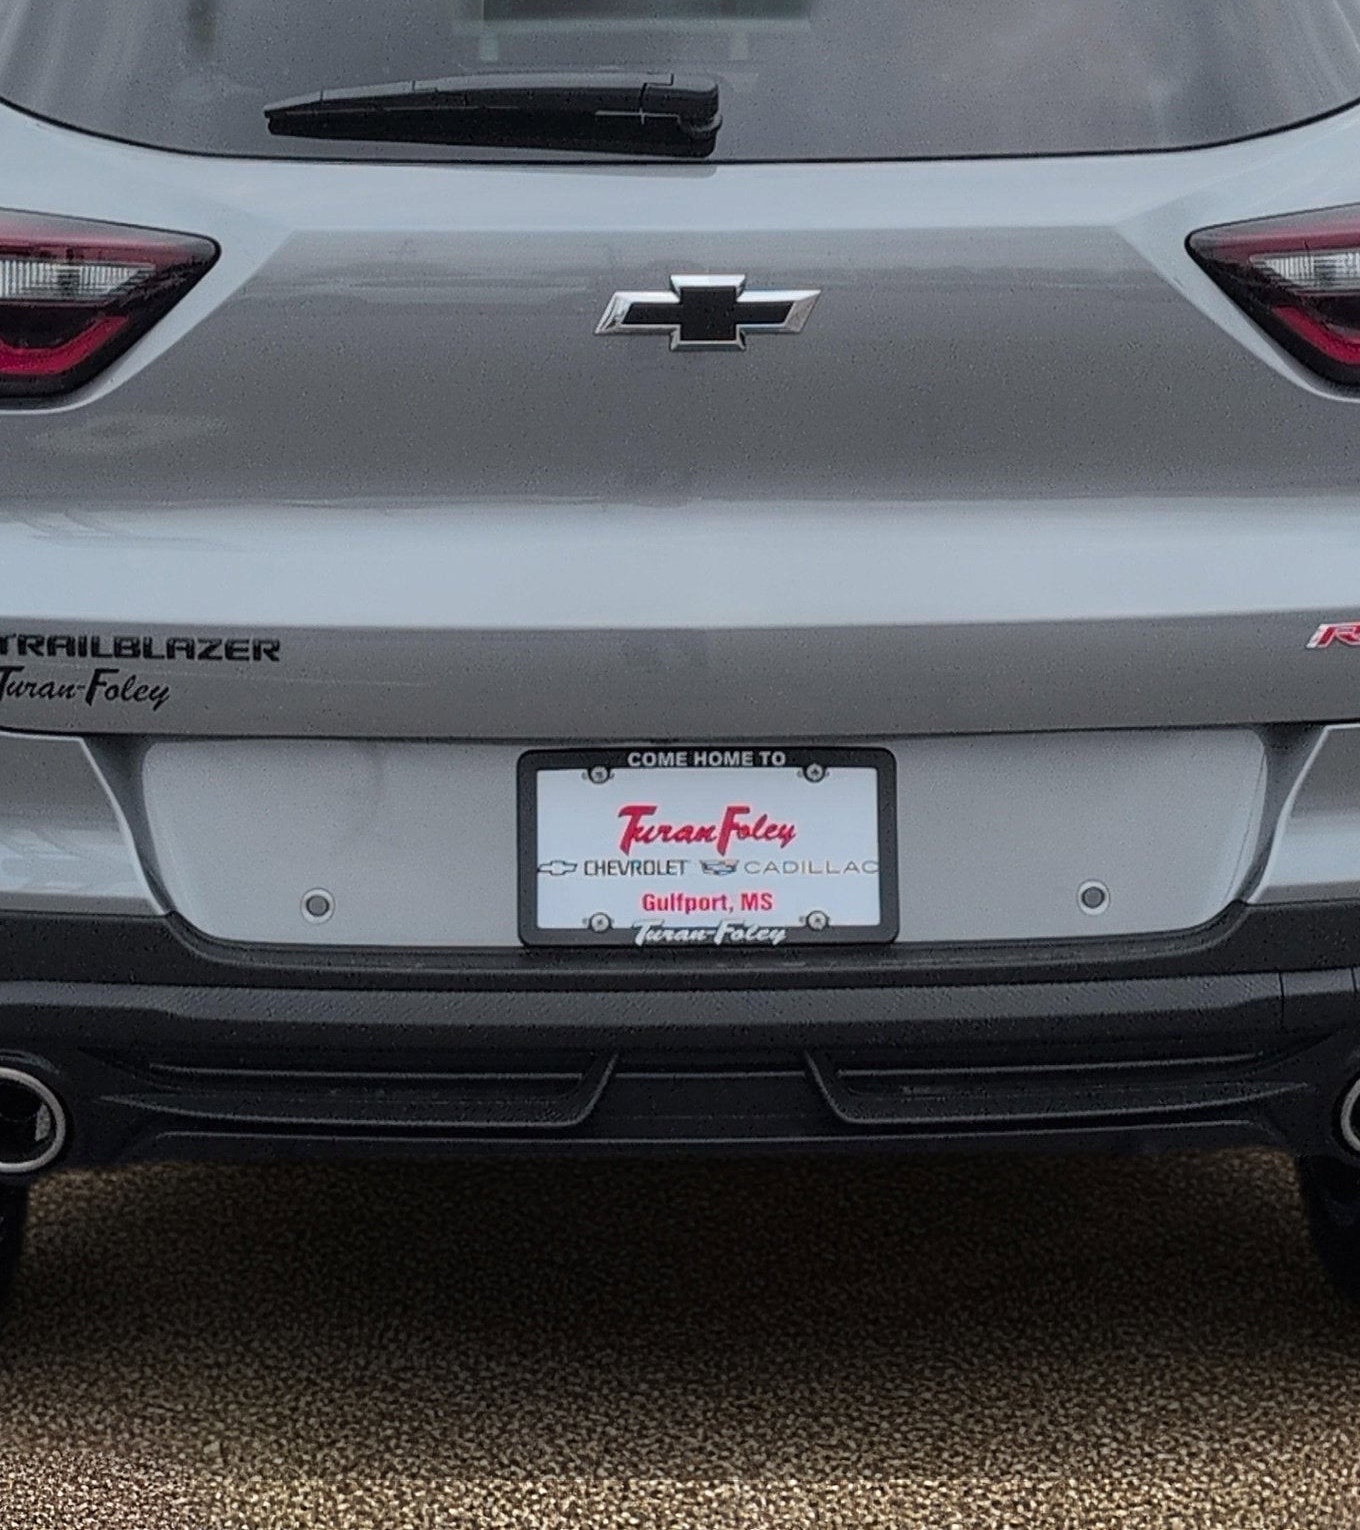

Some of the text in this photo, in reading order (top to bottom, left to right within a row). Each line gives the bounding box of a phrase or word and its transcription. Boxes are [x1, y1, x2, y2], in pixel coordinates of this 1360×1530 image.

[627, 750, 787, 768] COME HOME TO
[583, 859, 880, 876] CHEVROLET CADILLAC
[641, 893, 774, 913] Gulfport, MS
